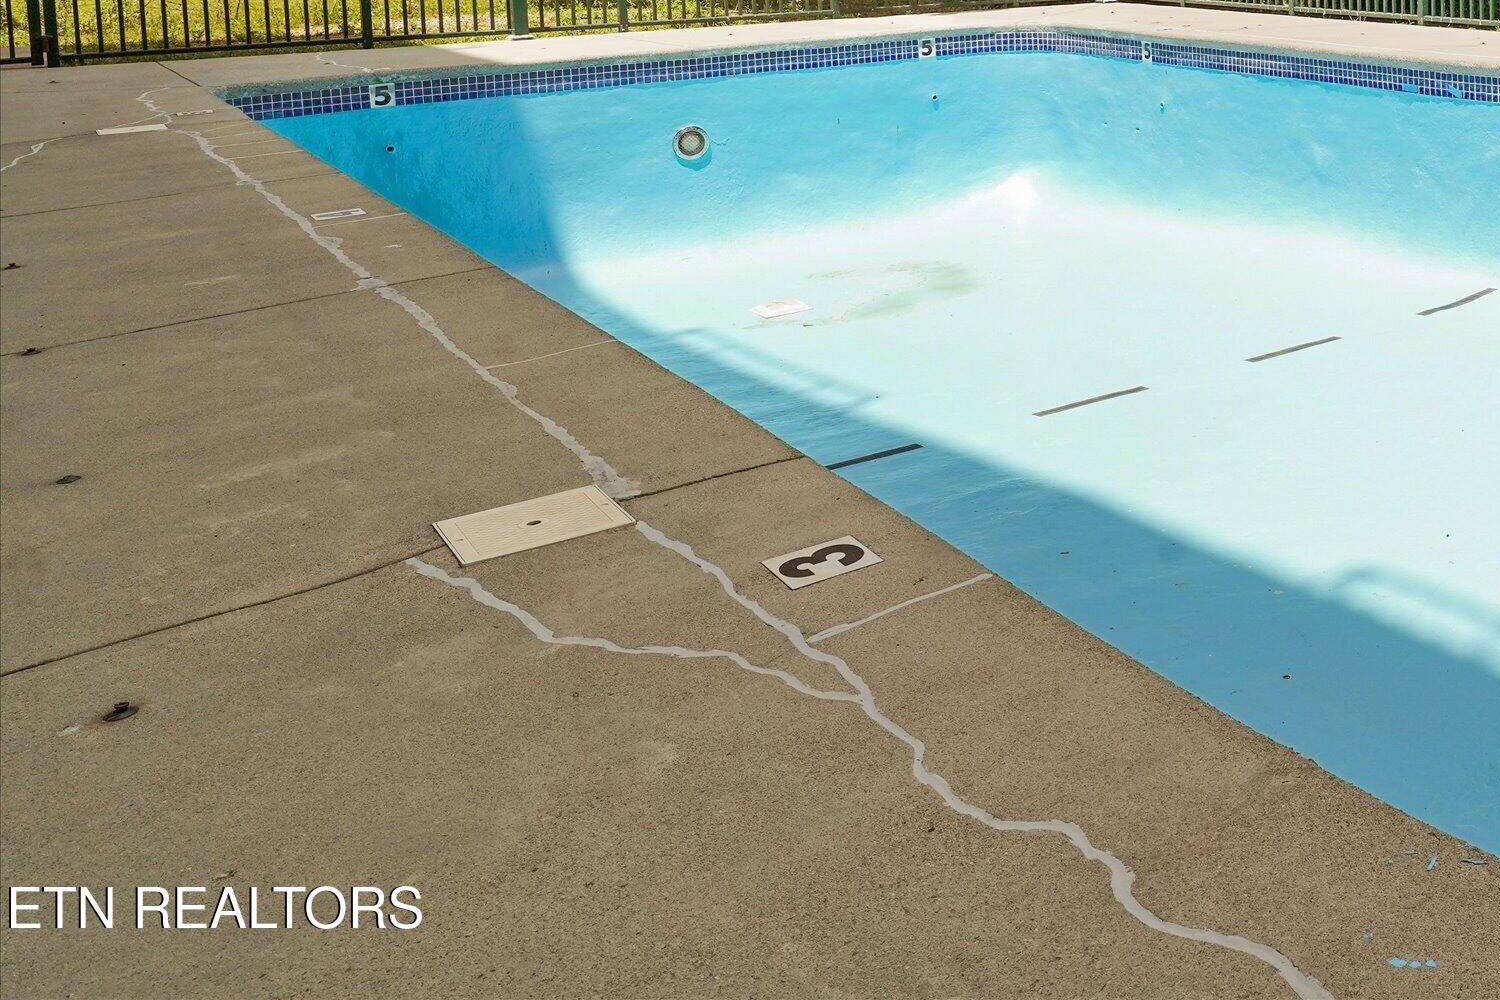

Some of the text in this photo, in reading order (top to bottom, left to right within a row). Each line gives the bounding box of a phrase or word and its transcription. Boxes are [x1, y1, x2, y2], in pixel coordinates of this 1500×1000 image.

[921, 39, 932, 56] 5
[1144, 43, 1151, 59] 5
[374, 85, 392, 105] 5
[778, 542, 864, 579] 3
